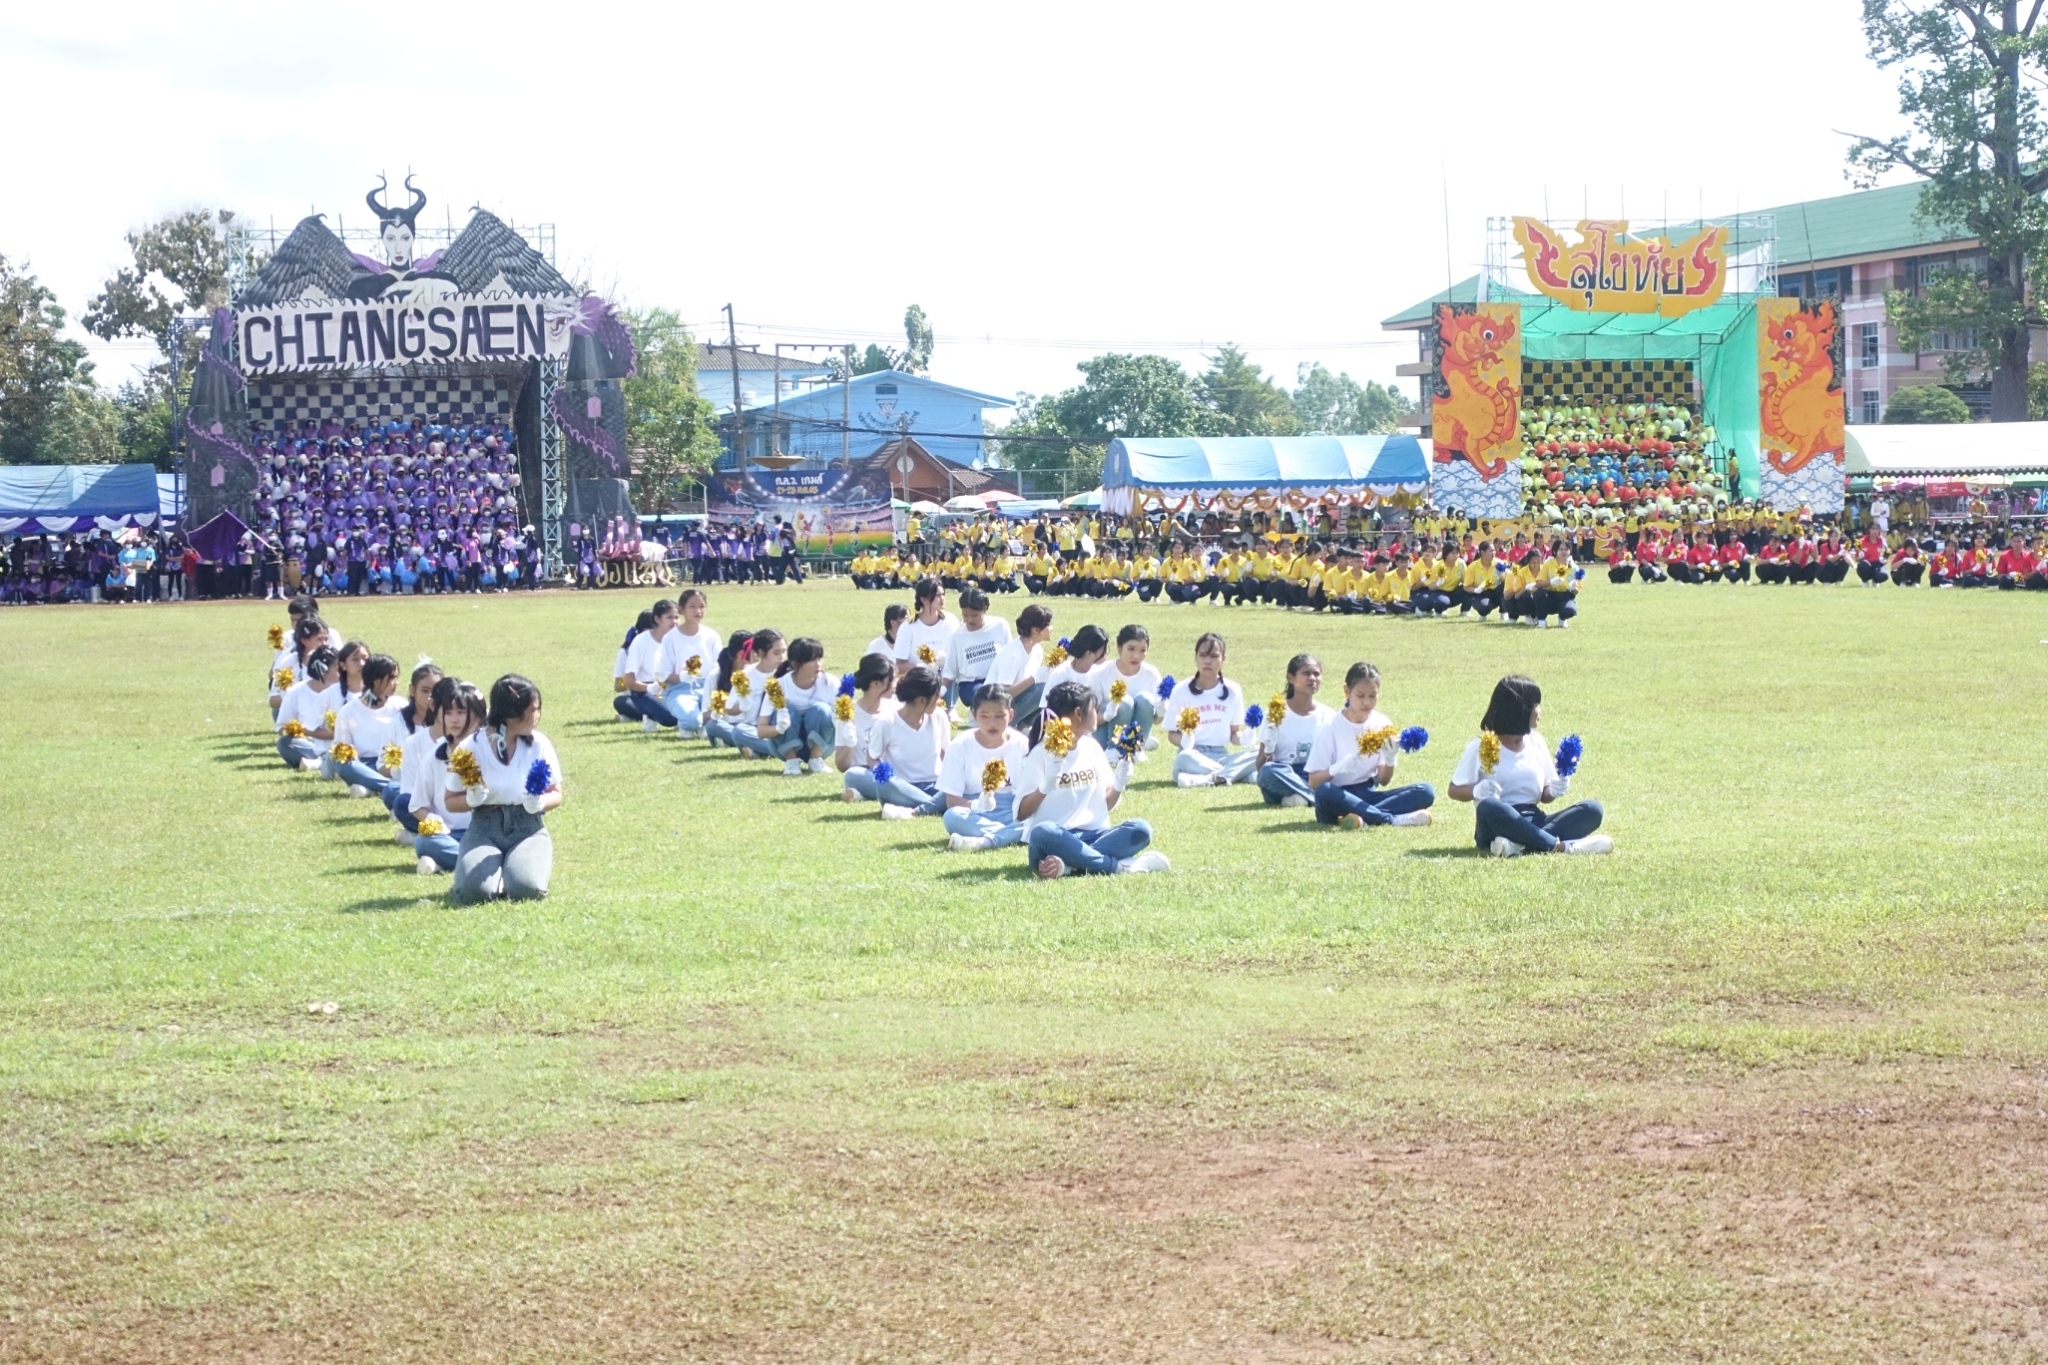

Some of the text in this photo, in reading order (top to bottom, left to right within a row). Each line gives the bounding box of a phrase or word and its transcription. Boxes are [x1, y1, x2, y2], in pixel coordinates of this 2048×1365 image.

[1570, 220, 1686, 308] สุโขทัย
[243, 303, 546, 368] CHIANGSAEN
[966, 645, 997, 660] BEGINNING
[1214, 704, 1227, 713] ME
[1059, 768, 1098, 787] epea
